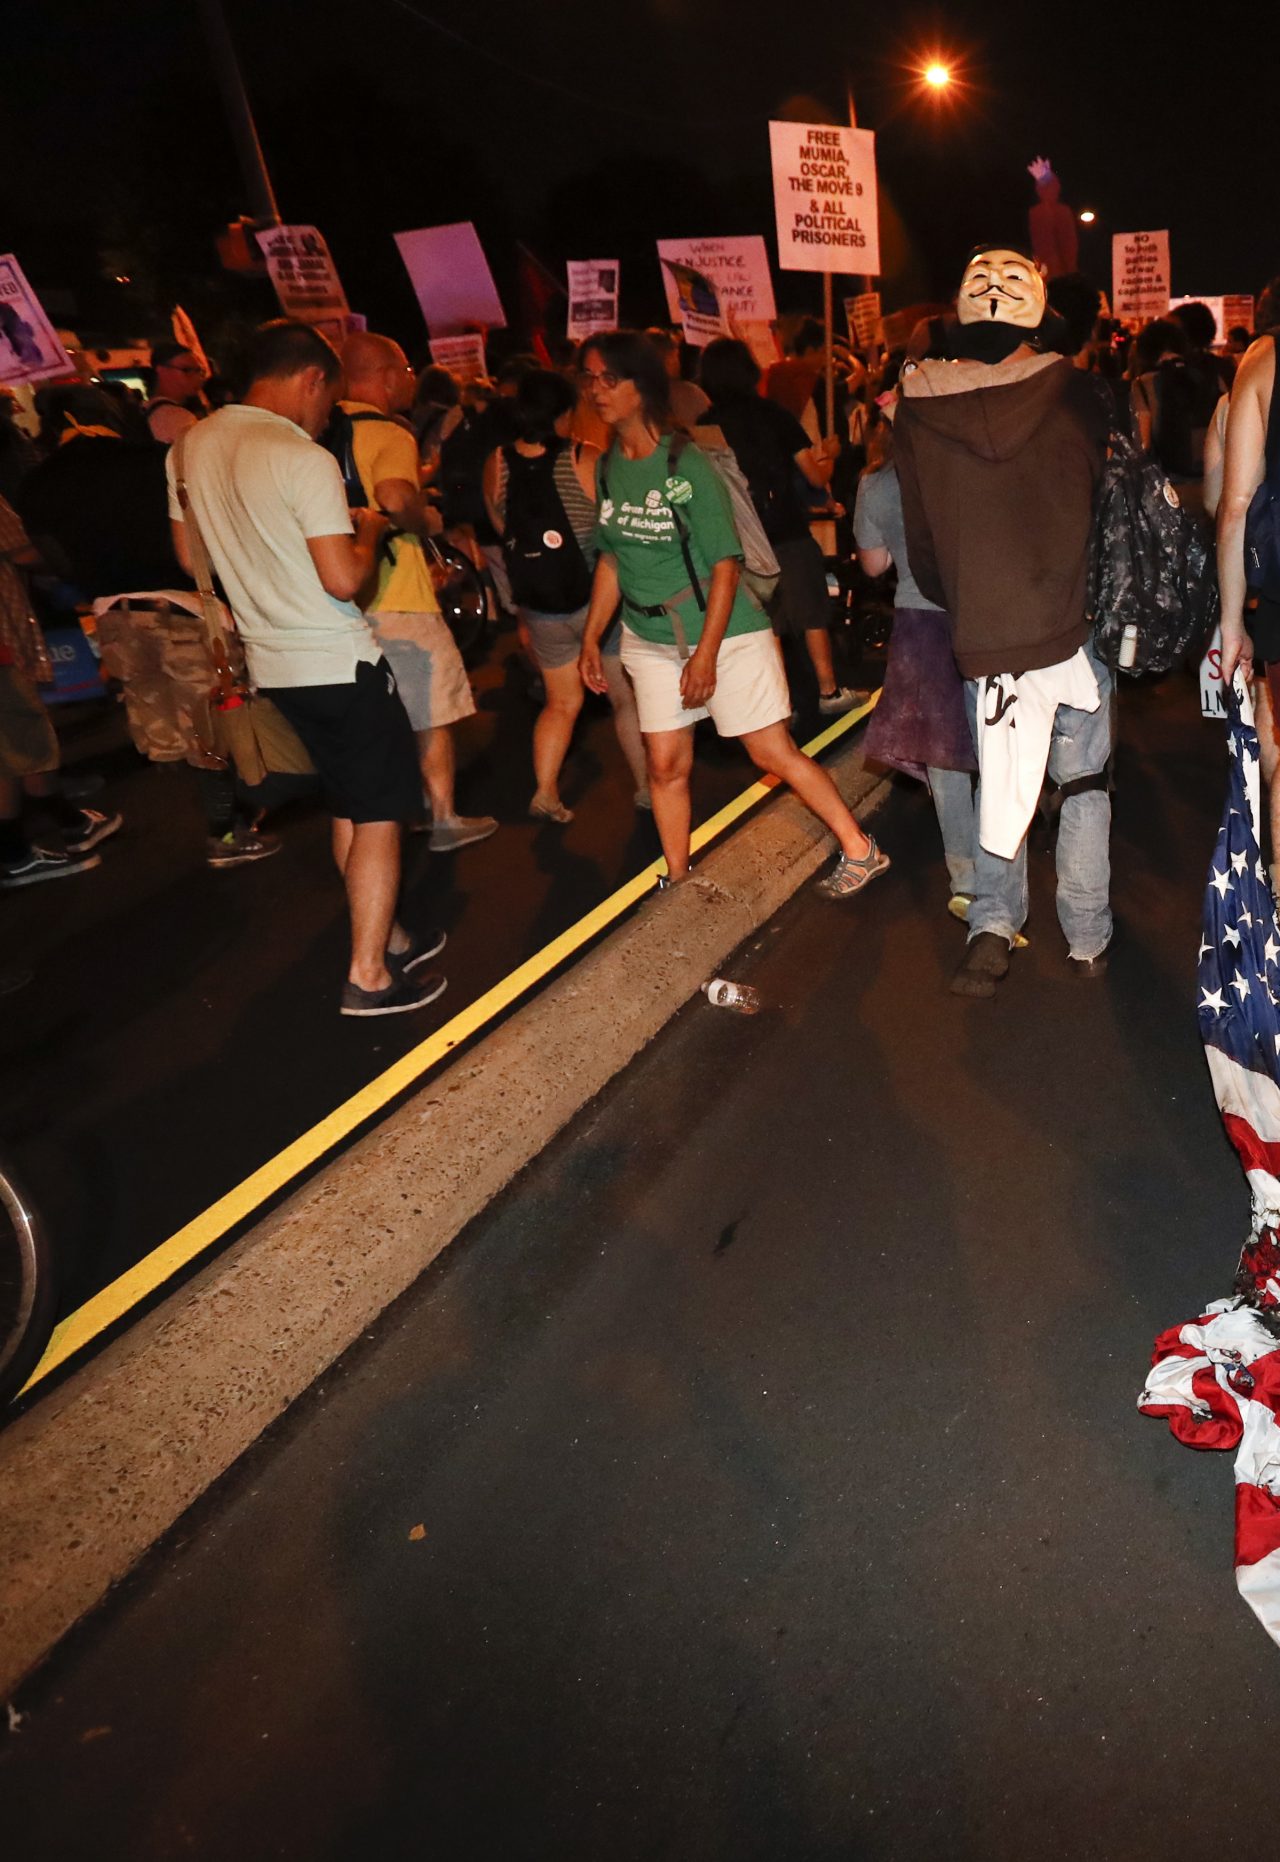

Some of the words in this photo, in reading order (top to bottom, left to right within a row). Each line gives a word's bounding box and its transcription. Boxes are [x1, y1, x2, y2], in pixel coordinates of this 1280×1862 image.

[807, 130, 840, 147] FREE
[799, 146, 849, 165] MUMIA,
[801, 162, 850, 182] OSCAR,
[788, 177, 815, 192] THE
[817, 180, 853, 196] MOVE
[855, 182, 863, 197] 9
[809, 199, 819, 213] &
[823, 200, 847, 215] ALL
[794, 213, 862, 232] POLITICAL
[792, 229, 866, 248] PRISONERS
[1134, 234, 1150, 243] NO
[617, 515, 630, 526] of
[630, 516, 675, 533] Michigan
